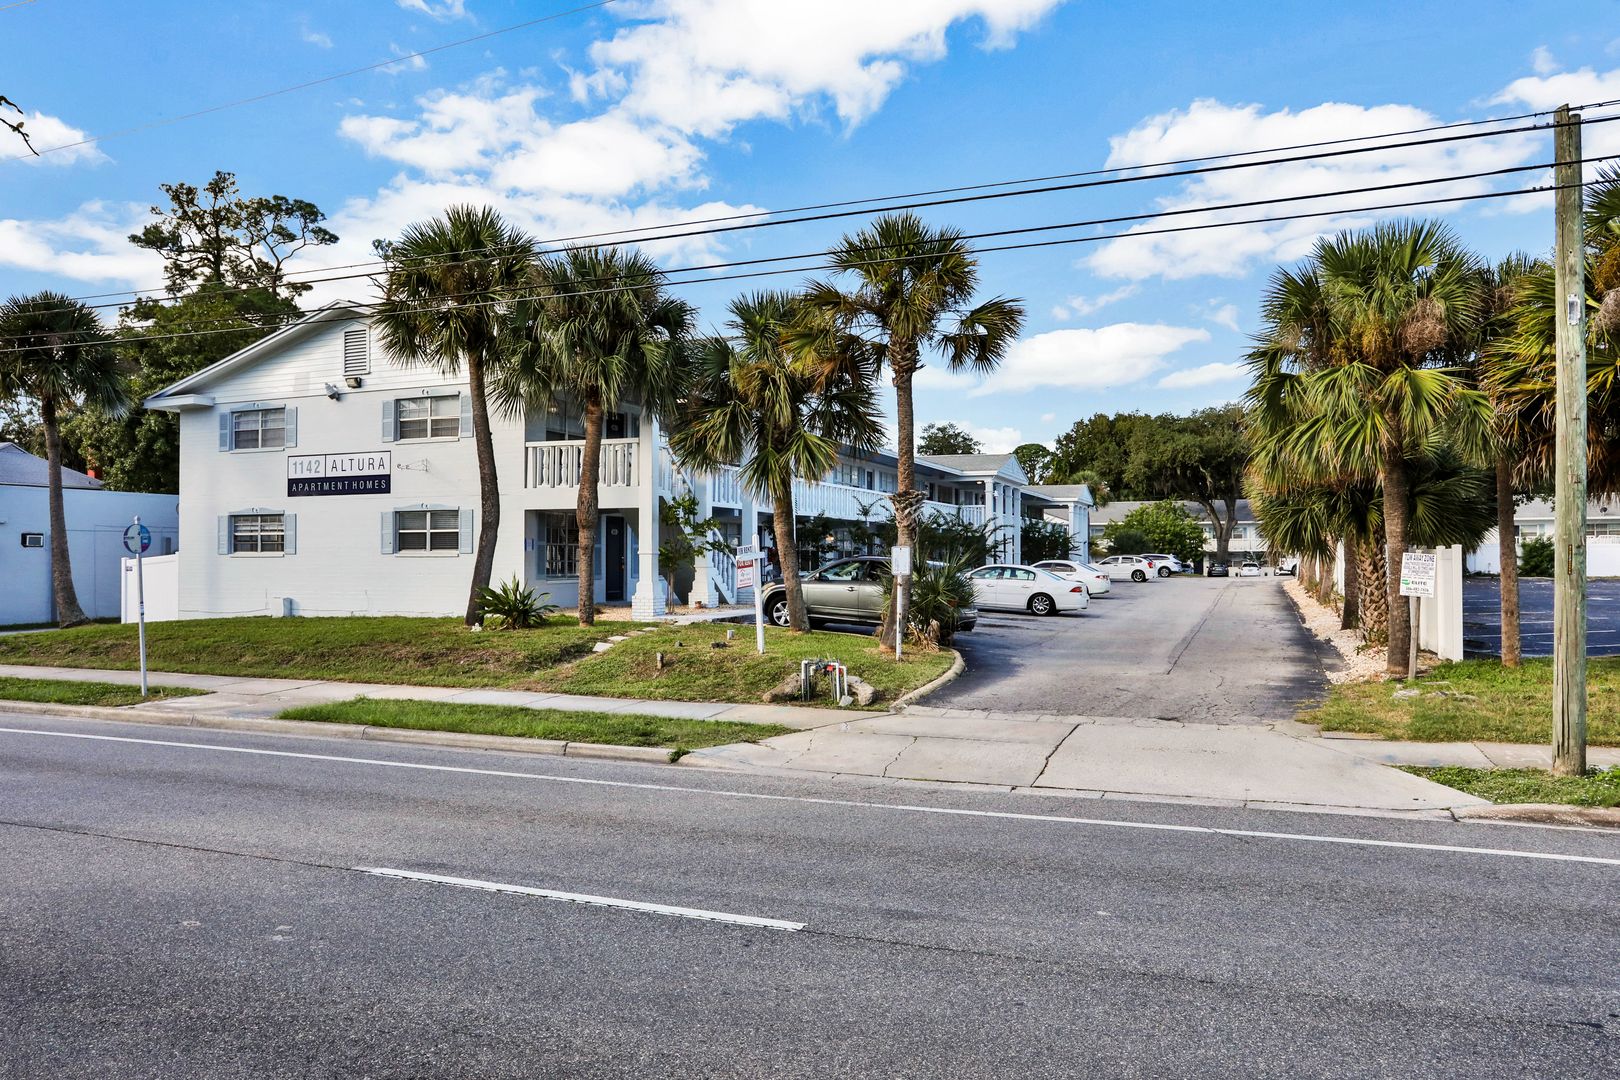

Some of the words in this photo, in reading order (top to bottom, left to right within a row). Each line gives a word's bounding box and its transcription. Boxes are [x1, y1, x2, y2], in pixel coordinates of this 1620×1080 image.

[293, 459, 321, 475] 1142
[331, 457, 386, 472] ALTURA
[292, 481, 349, 492] APARTMENT
[352, 479, 386, 490] HOMES
